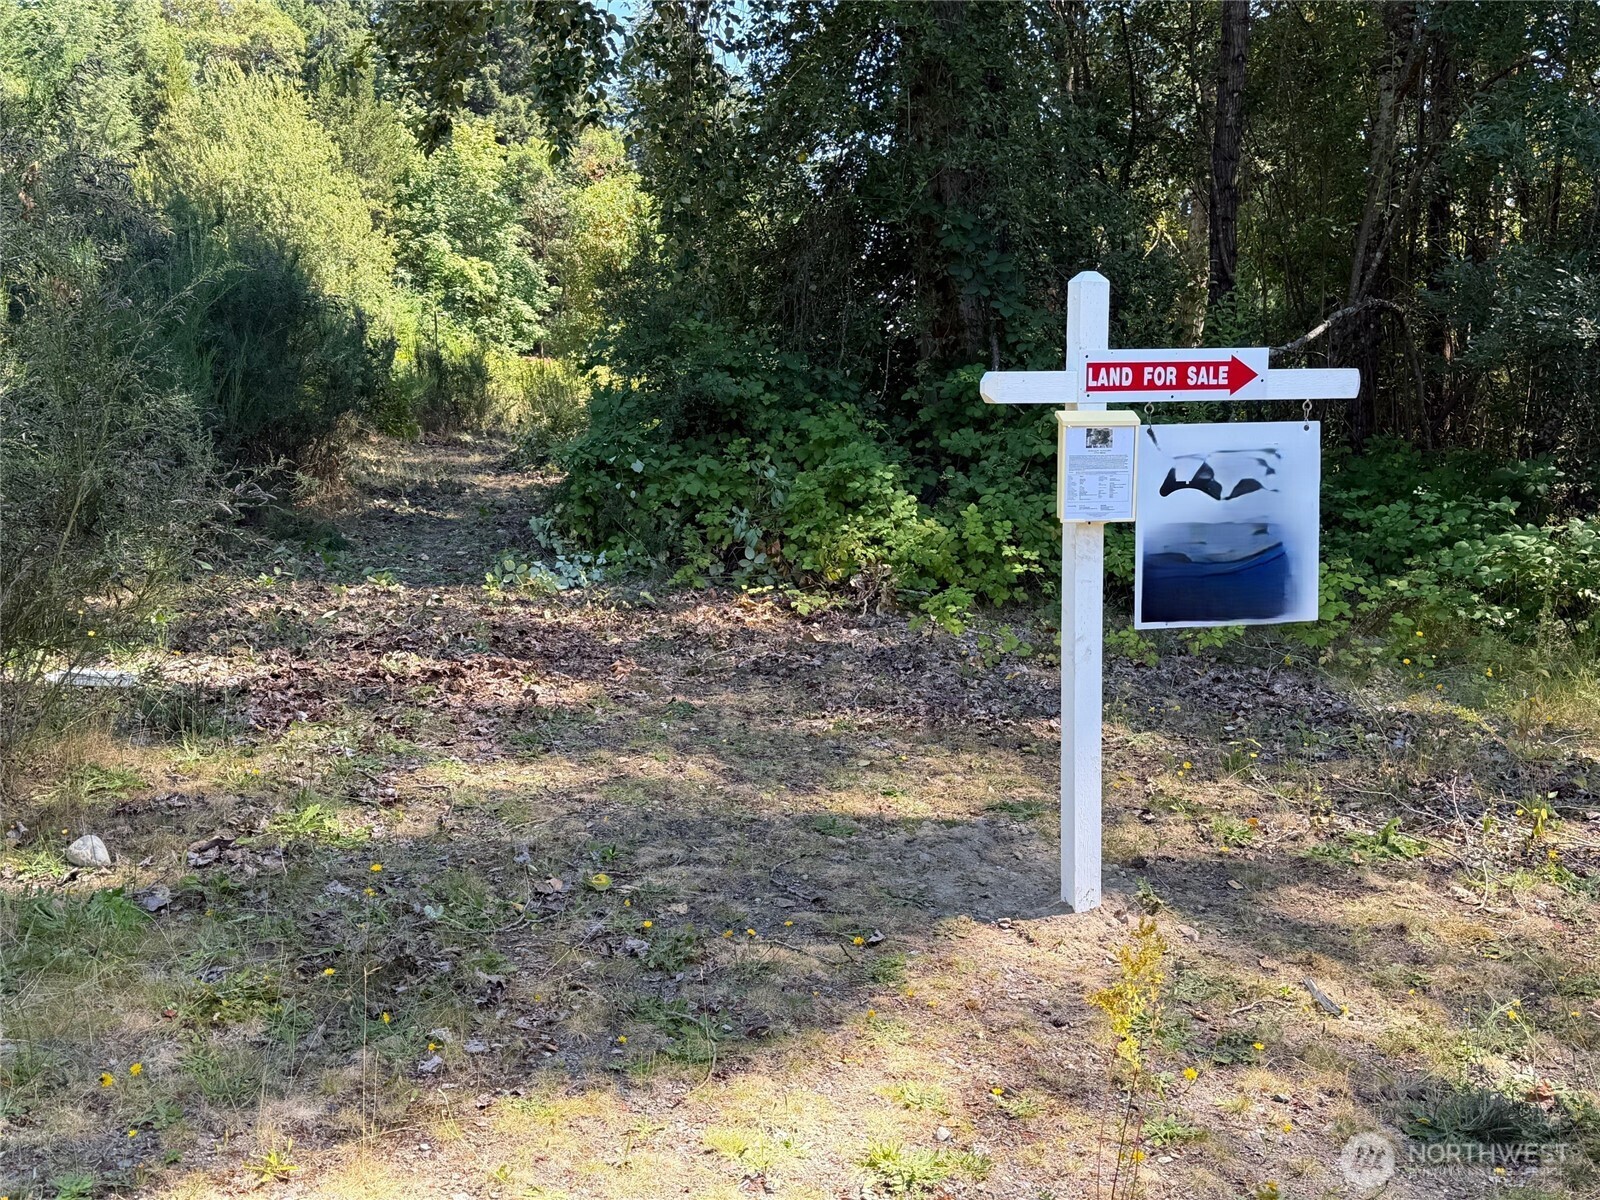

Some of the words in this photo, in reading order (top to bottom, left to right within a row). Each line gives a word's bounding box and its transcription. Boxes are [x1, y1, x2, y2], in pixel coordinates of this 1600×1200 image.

[1088, 367, 1133, 387] LAND
[1143, 366, 1177, 386] FOR
[1187, 365, 1229, 386] SALE
